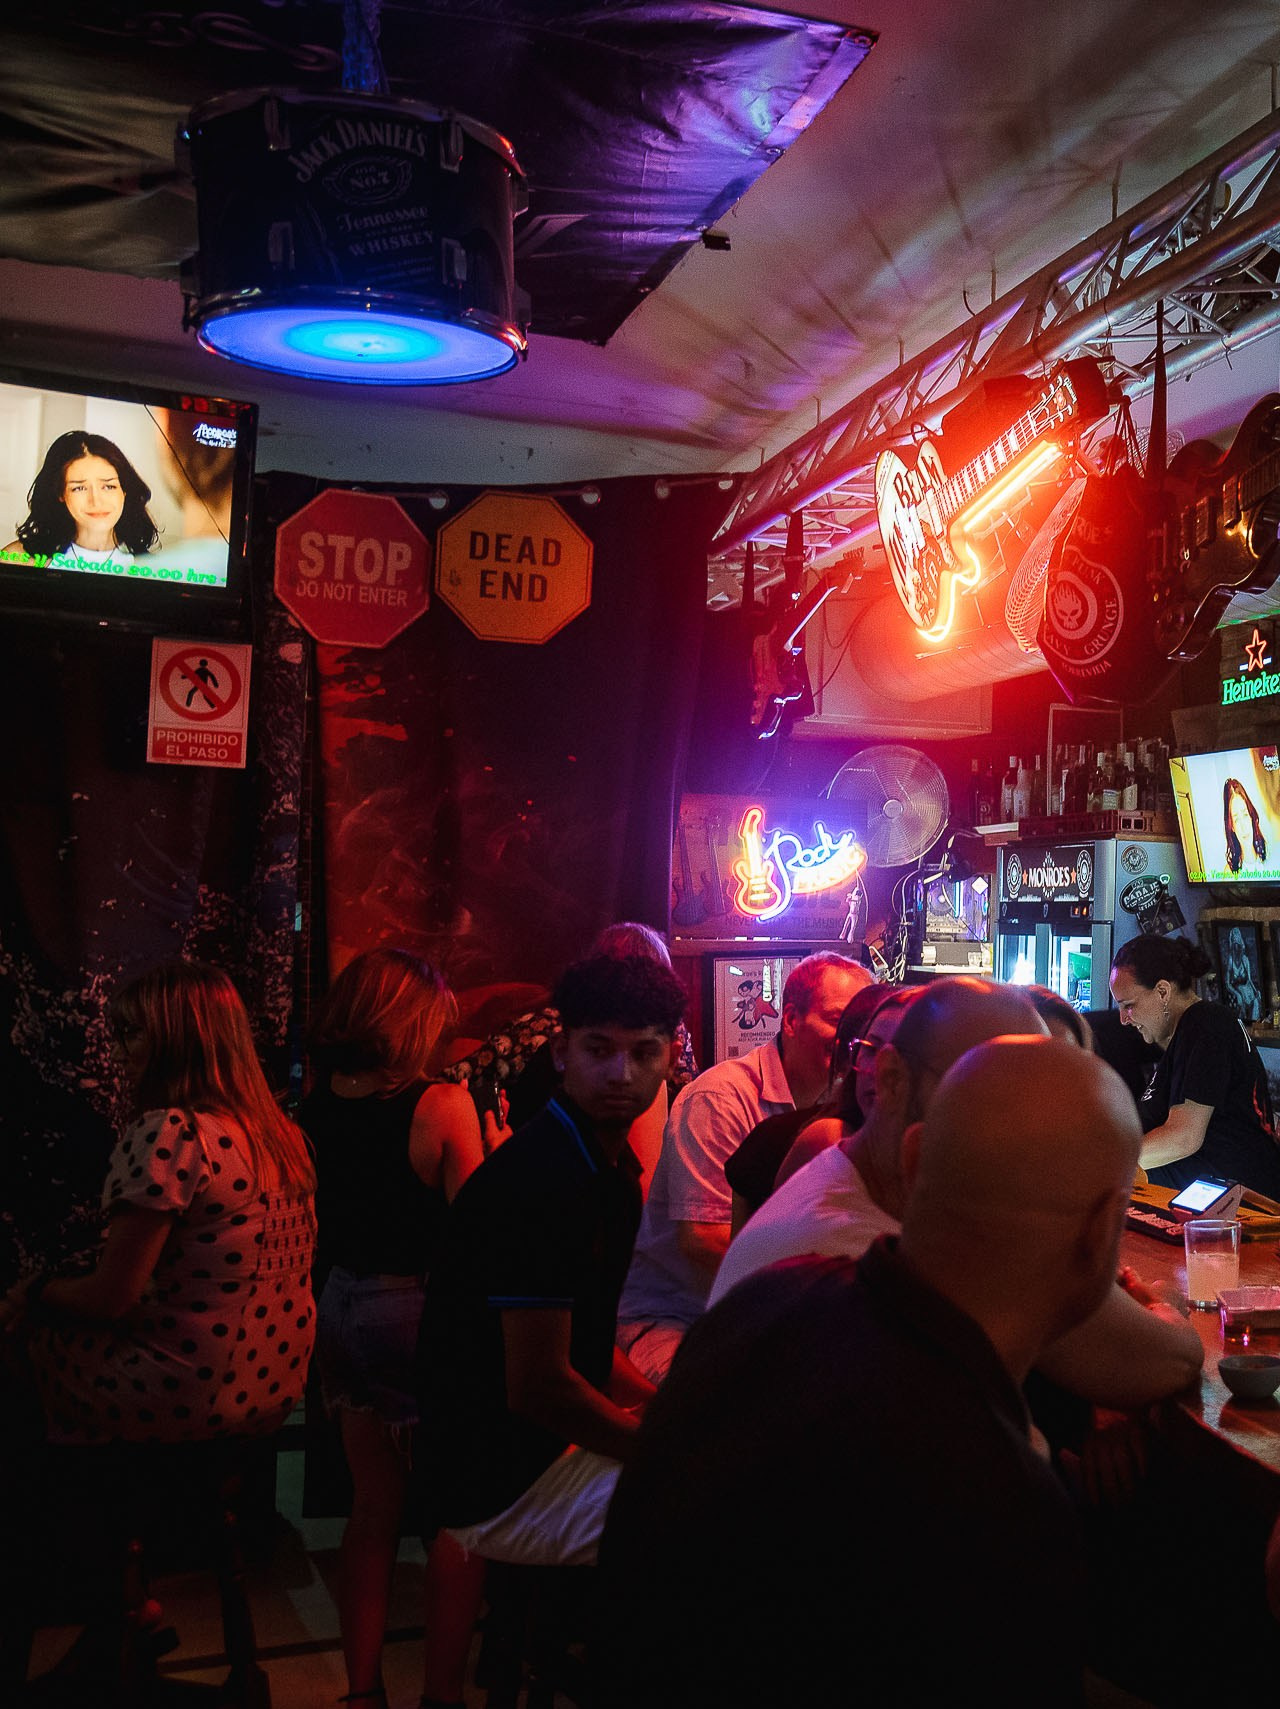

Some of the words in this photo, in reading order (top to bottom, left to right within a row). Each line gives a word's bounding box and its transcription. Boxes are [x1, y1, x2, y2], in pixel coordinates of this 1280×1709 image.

[288, 130, 343, 184] JACK
[335, 119, 428, 162] DANIEL'S
[337, 207, 429, 231] Tennessee
[350, 230, 433, 256] WHISKEY
[298, 531, 412, 586] STOP
[469, 530, 562, 567] DEAD
[51, 552, 124, 575] Sabado
[187, 568, 217, 585] hrs
[296, 580, 319, 598] DO
[323, 582, 355, 601] NOT
[359, 586, 407, 607] ENTER
[479, 569, 548, 603] END
[1084, 597, 1117, 656] GRUNGE
[156, 730, 239, 746] PROHIBIDO
[166, 745, 184, 757] EL
[189, 746, 228, 760] PASO
